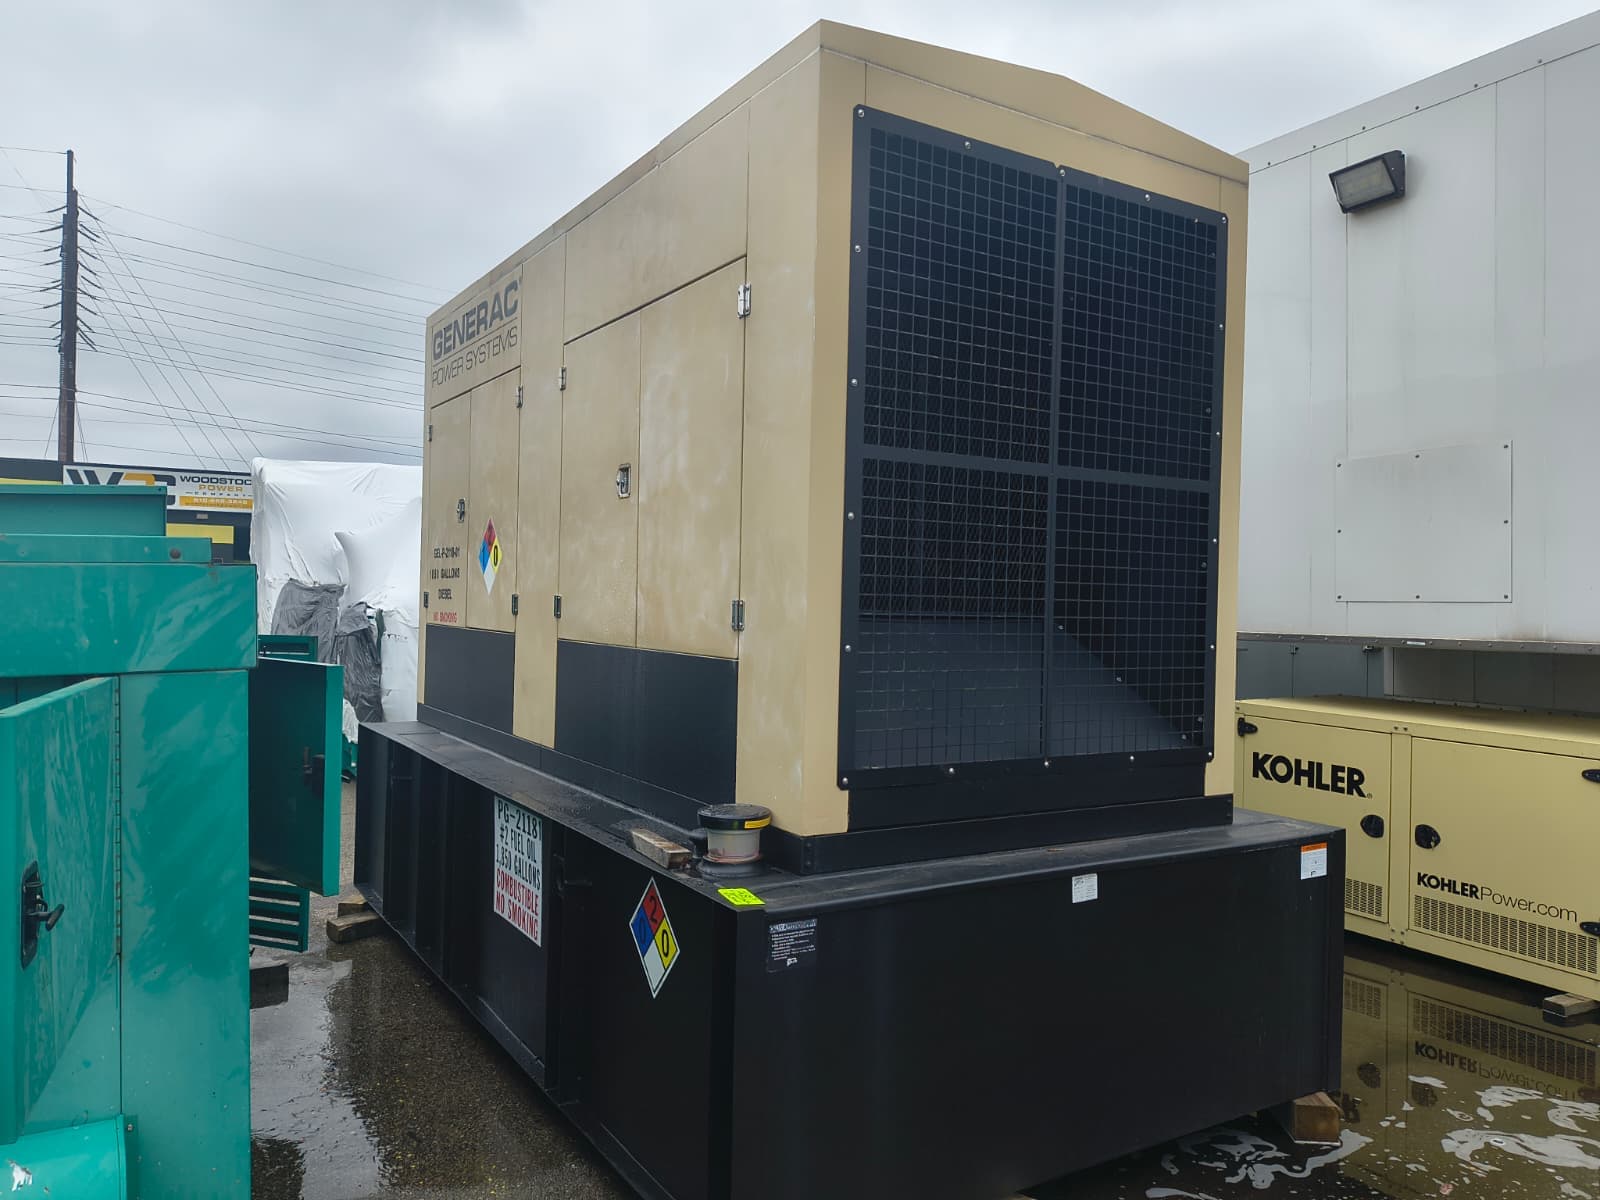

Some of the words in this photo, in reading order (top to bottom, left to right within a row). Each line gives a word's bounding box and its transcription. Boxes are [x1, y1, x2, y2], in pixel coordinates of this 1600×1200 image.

[433, 280, 518, 360] GENERAC
[431, 357, 463, 388] POWER
[466, 326, 517, 370] SYSTEMS
[199, 484, 243, 492] POWER
[493, 545, 498, 567] 0
[438, 588, 452, 600] DIESEL
[1252, 751, 1366, 798] KOHLER
[511, 828, 525, 856] FUEL
[527, 837, 538, 863] OIL
[514, 854, 540, 891] GALLONS
[496, 868, 539, 917] COMBUSTIBLE
[649, 895, 658, 923] 2
[1417, 871, 1577, 922] KOHLERPower.com
[496, 889, 505, 914] NO
[508, 898, 538, 941] SMOKING
[661, 928, 670, 958] 0
